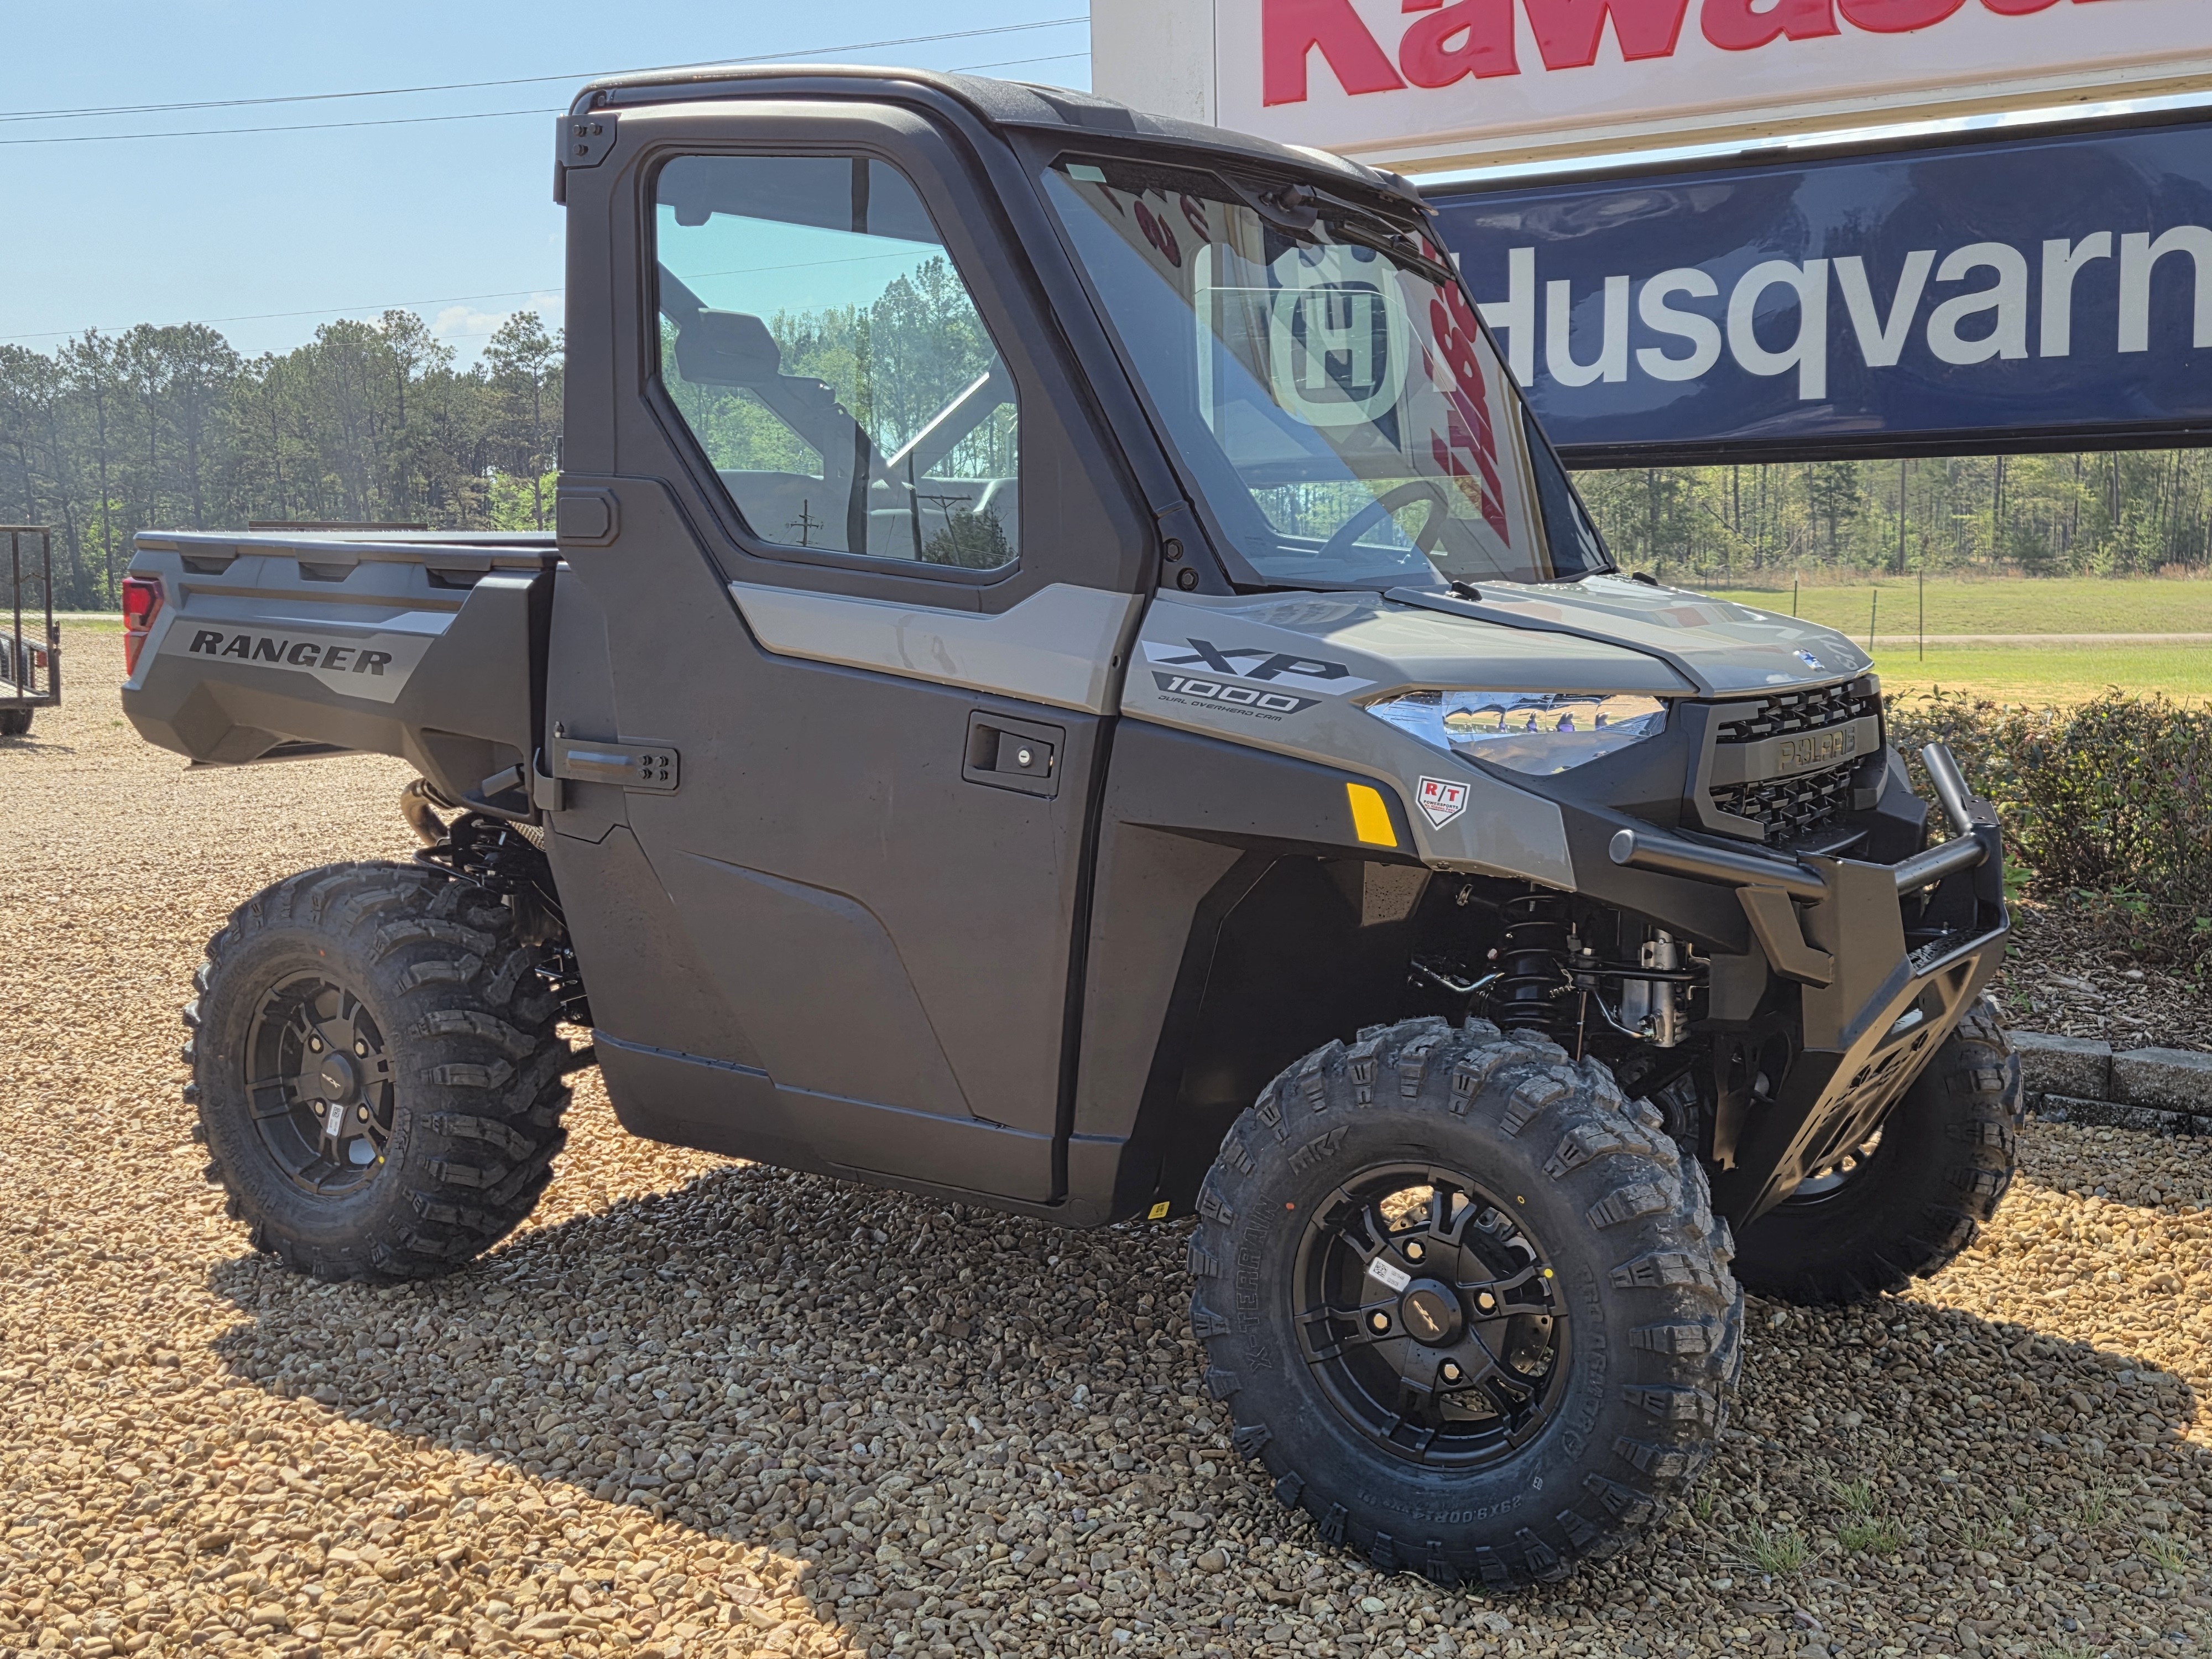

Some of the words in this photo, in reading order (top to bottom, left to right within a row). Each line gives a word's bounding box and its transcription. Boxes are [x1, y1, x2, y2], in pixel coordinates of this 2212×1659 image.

[189, 630, 392, 676] RANGER
[1153, 638, 1350, 681] XP
[1157, 695, 1187, 705] DUAL
[1191, 701, 1254, 717] OVERHEAD
[1254, 712, 1282, 722] CAM
[1167, 676, 1300, 712] 1000
[1778, 726, 1855, 771] POLARIS
[1423, 800, 1459, 810] POWERSPORTS
[1425, 782, 1460, 802] R/T
[1237, 1194, 1280, 1373] X-TERRAIN
